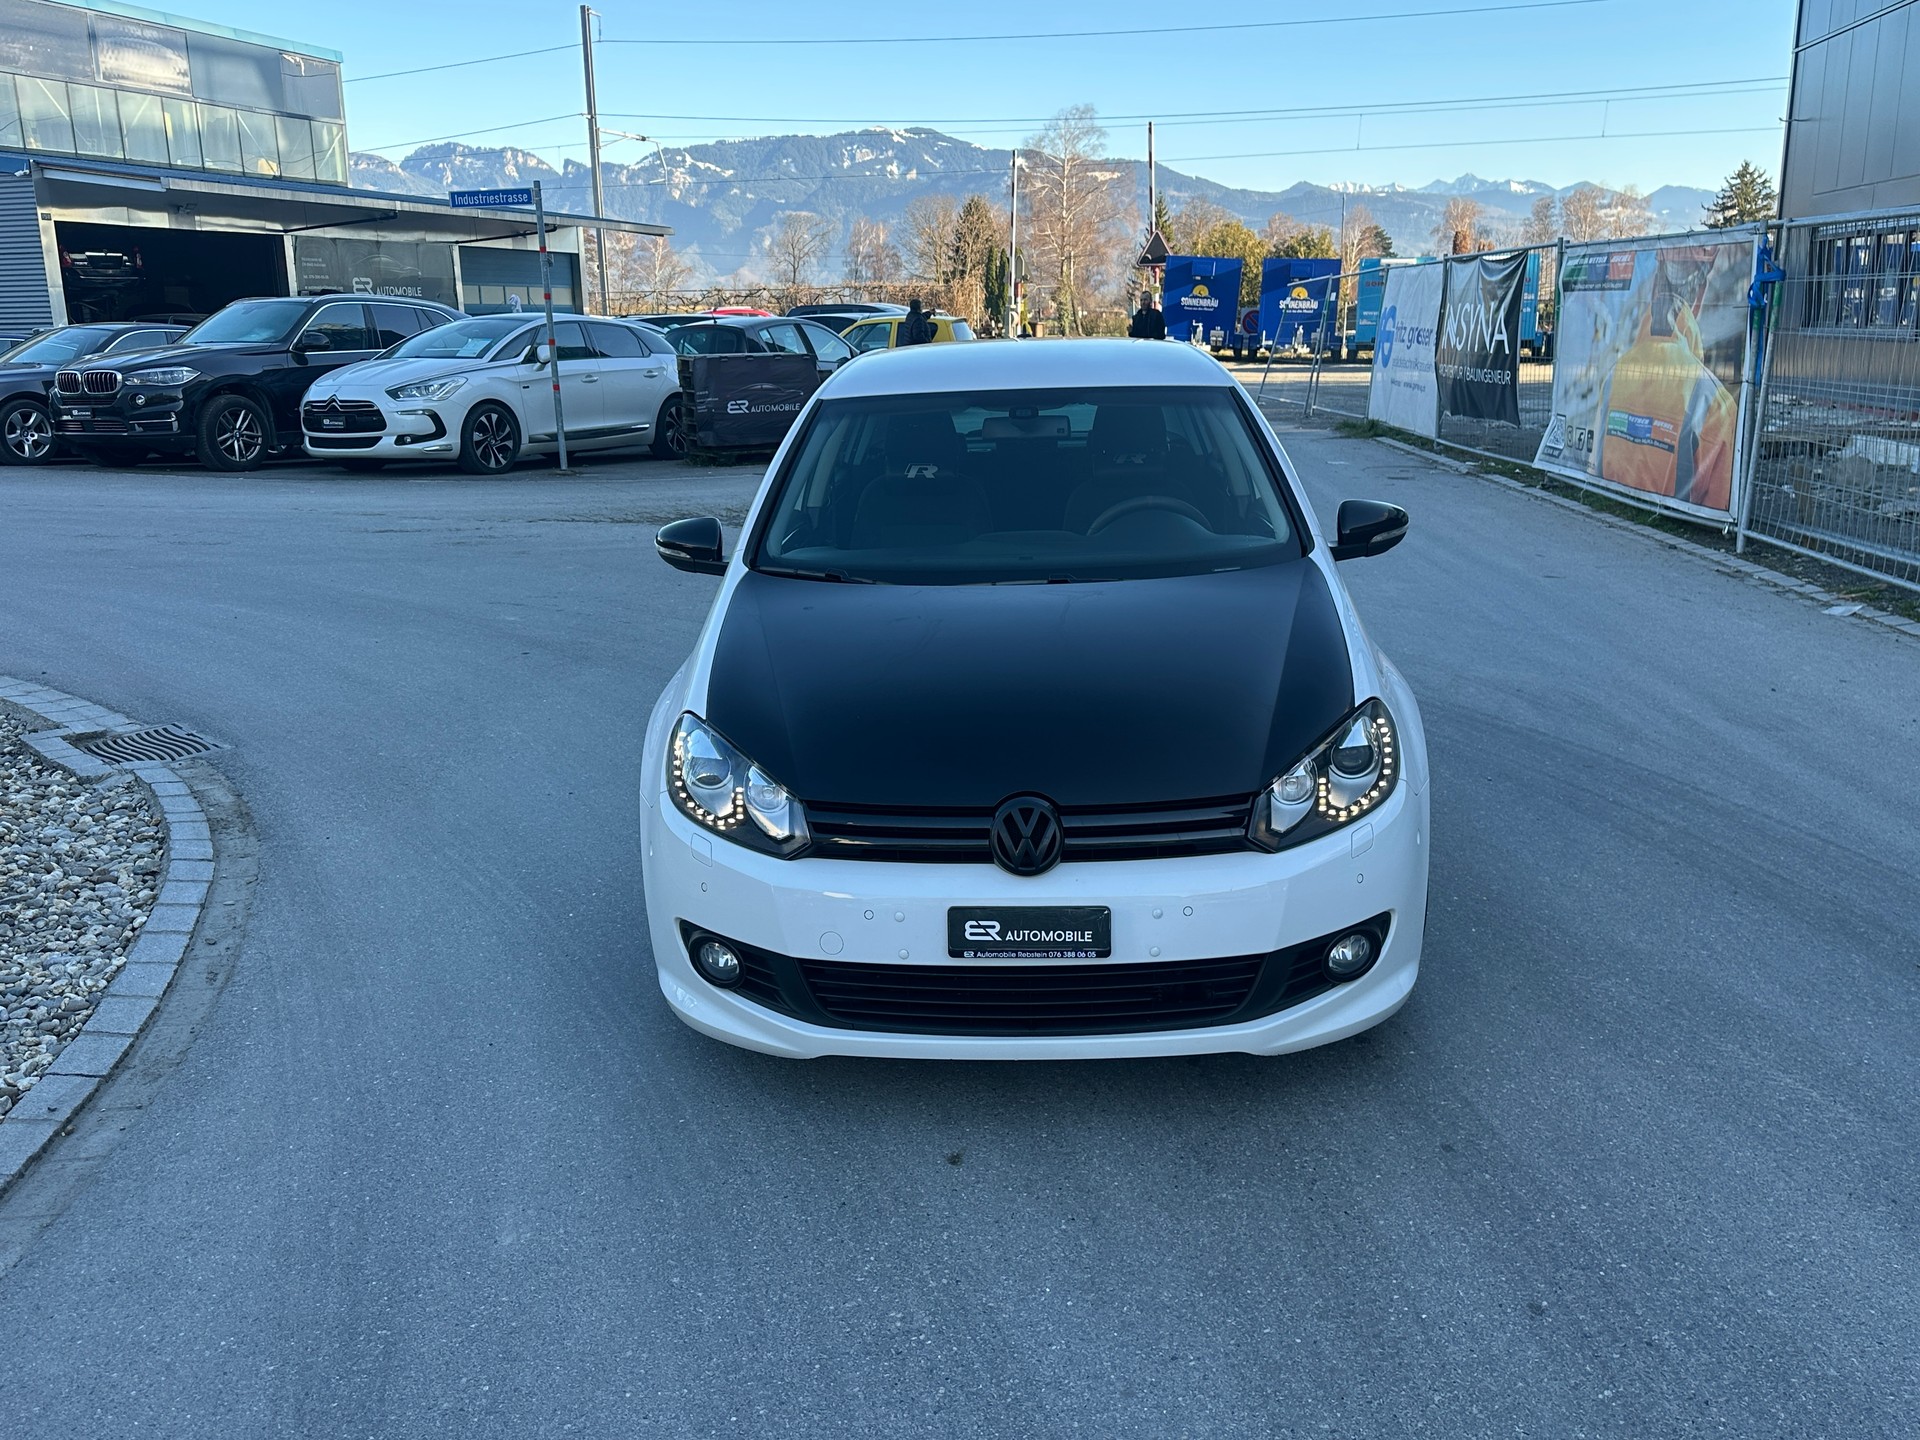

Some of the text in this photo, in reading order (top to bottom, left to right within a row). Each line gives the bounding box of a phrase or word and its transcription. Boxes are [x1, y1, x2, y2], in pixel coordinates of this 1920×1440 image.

[454, 192, 528, 205] Industriestrasse
[376, 286, 422, 297] AUTOMOBILE
[1278, 299, 1318, 310] SONENBRÄU
[1441, 302, 1510, 355] INSYNA
[751, 403, 800, 413] AUTOMOBILE
[1005, 930, 1093, 942] AUTOMOBILE
[976, 950, 1016, 958] Automobile
[1017, 950, 1047, 958] Rebstein
